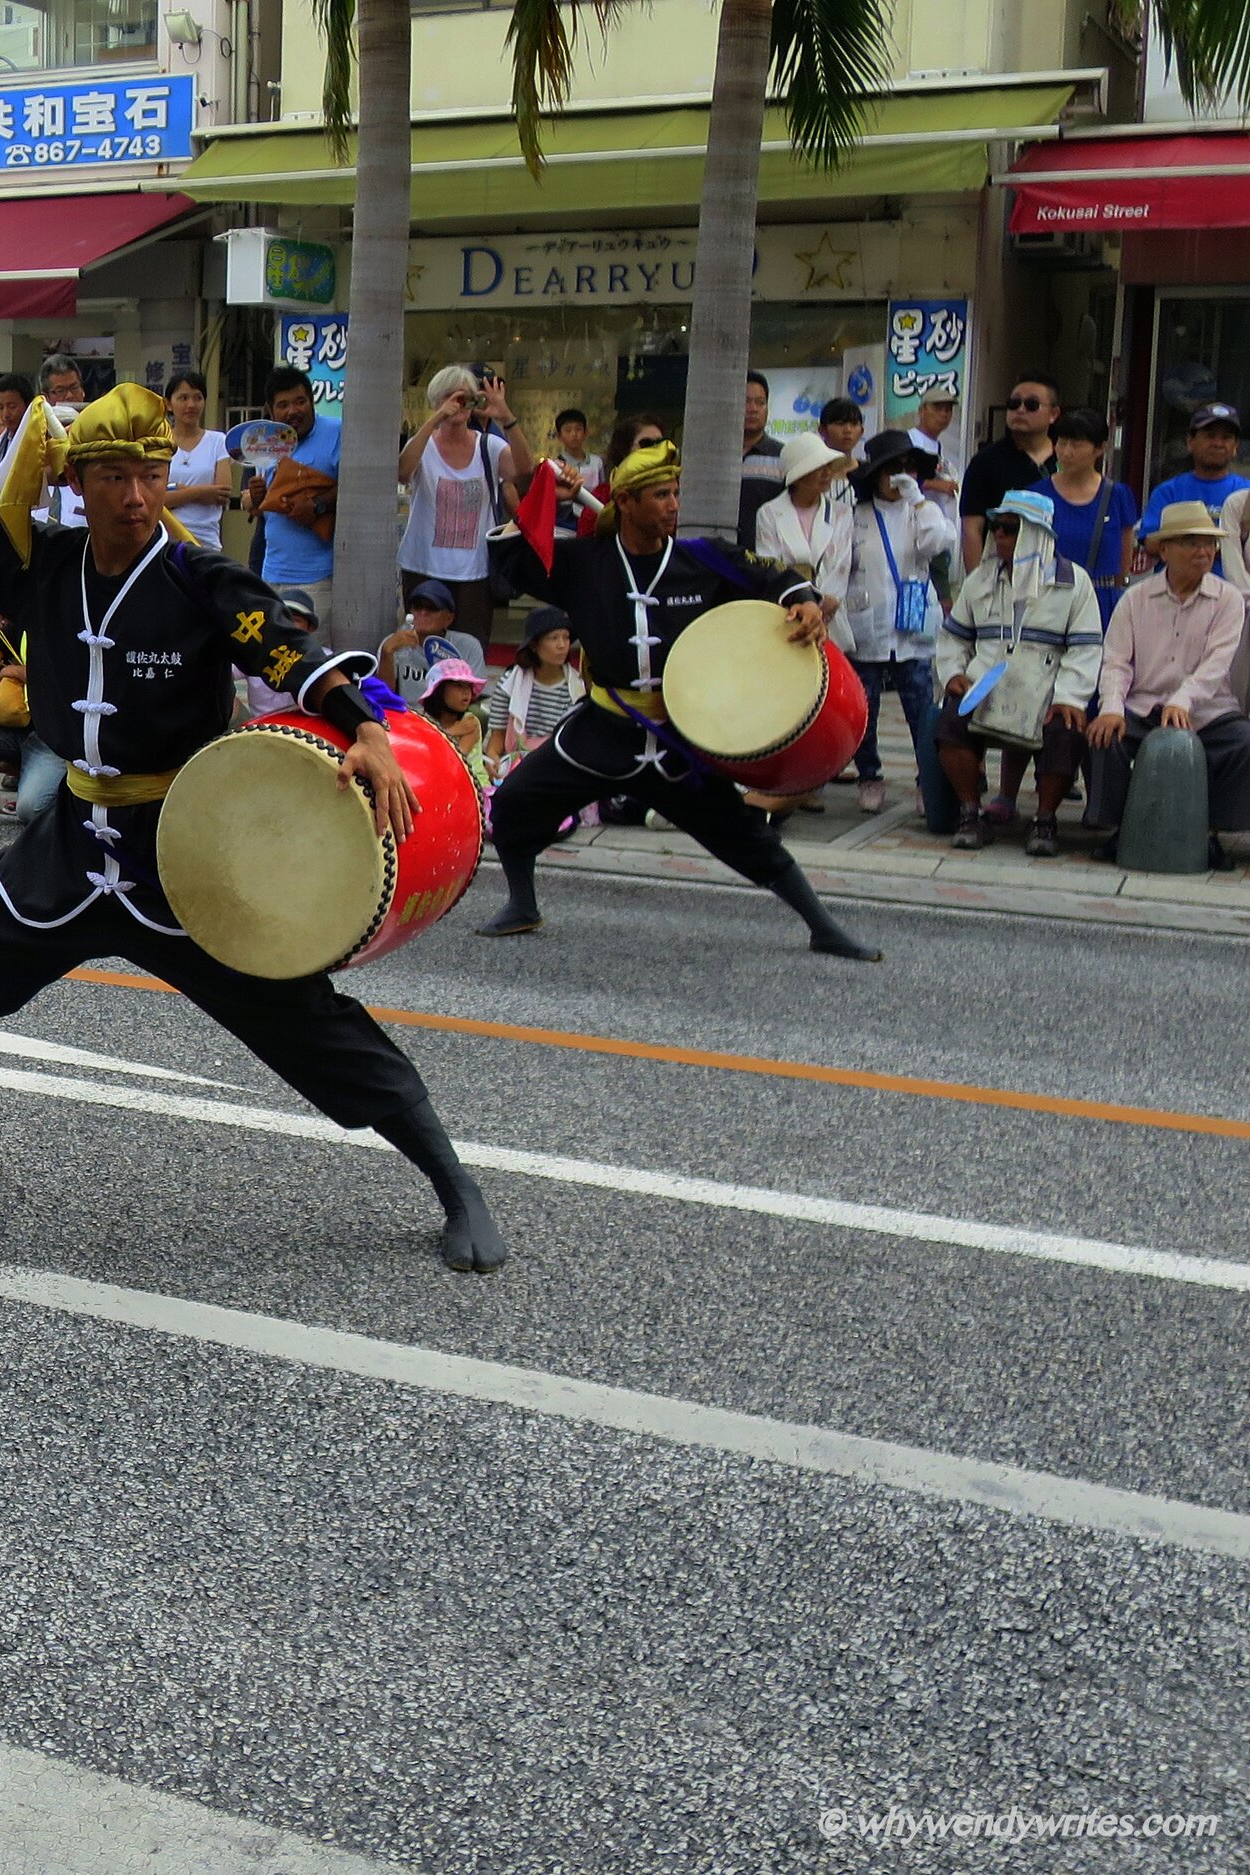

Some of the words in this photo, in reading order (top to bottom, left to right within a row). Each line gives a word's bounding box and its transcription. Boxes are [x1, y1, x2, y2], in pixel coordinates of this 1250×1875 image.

[34, 134, 161, 165] 867-4743
[1037, 205, 1099, 220] Kokusai
[1103, 203, 1150, 219] Street
[460, 245, 759, 298] DEARRYU
[891, 309, 964, 365] 星砂
[891, 370, 958, 397] ピアス
